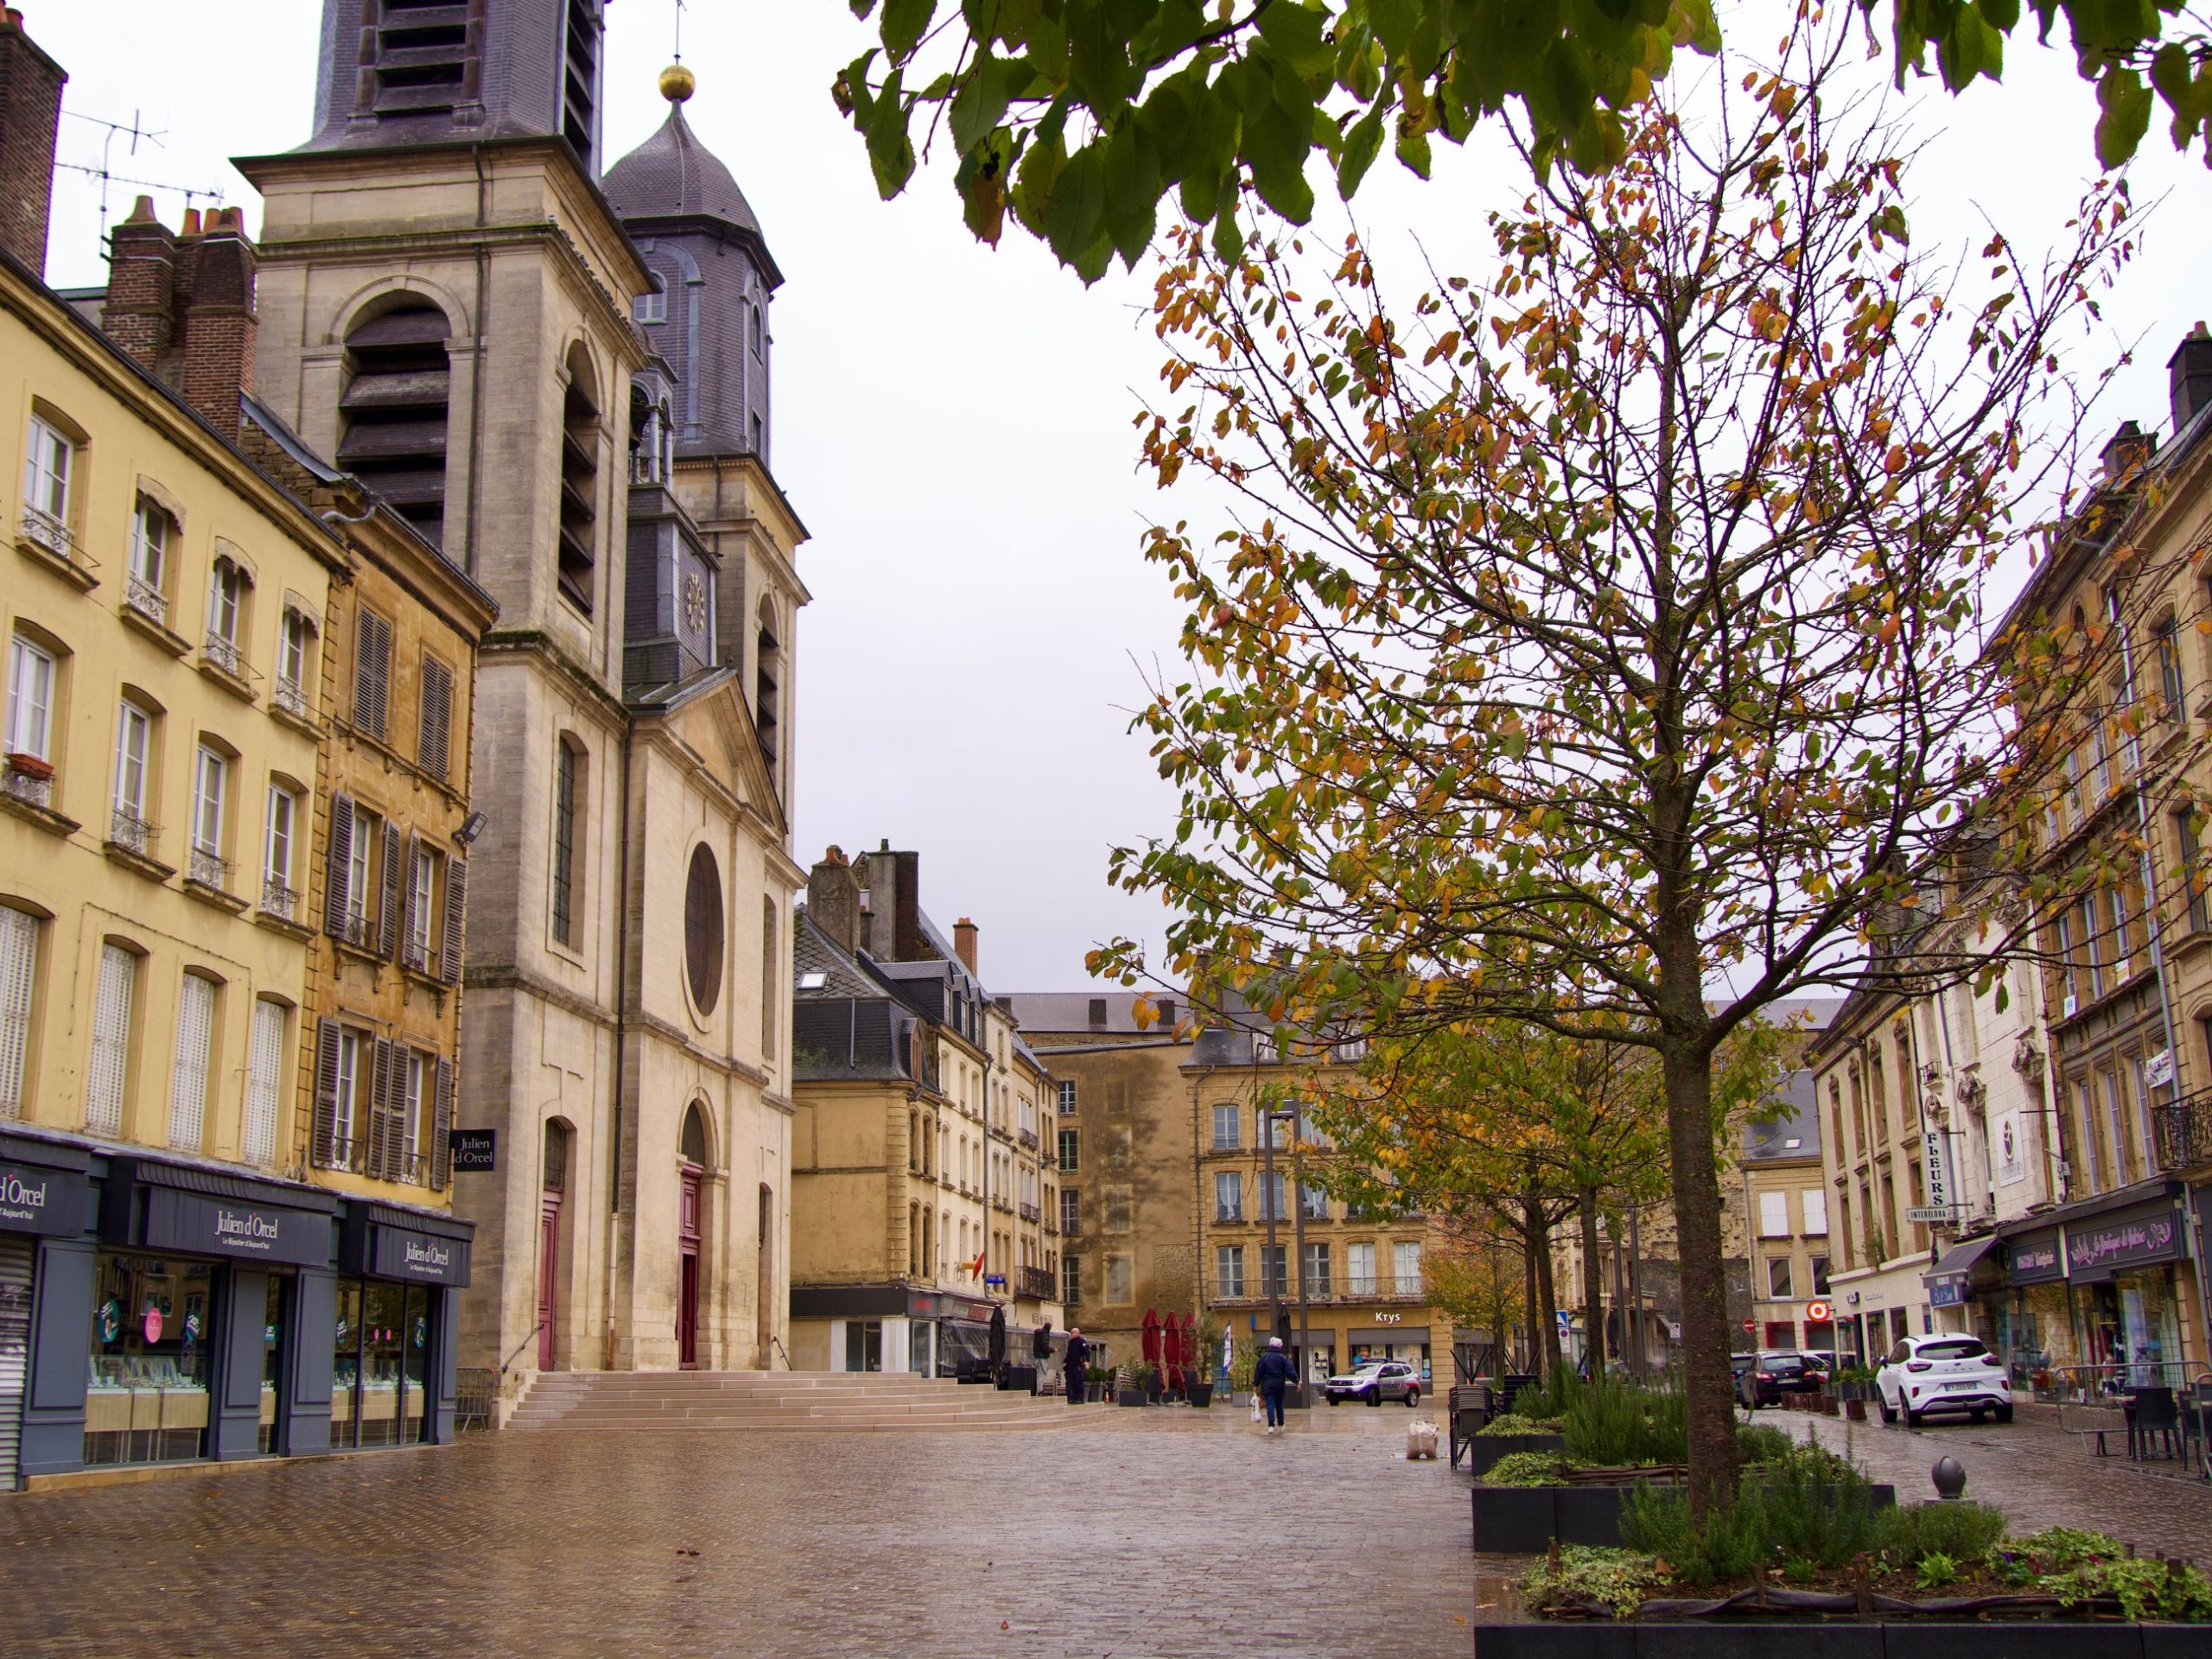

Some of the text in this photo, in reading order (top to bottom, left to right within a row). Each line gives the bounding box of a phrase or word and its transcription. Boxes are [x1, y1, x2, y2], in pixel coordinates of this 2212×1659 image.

[459, 1137, 490, 1151] Julien
[1927, 1134, 1943, 1205] FLEURS
[214, 1211, 244, 1235] Julien
[404, 1242, 424, 1262] Julien
[1376, 1312, 1401, 1325] Krys
